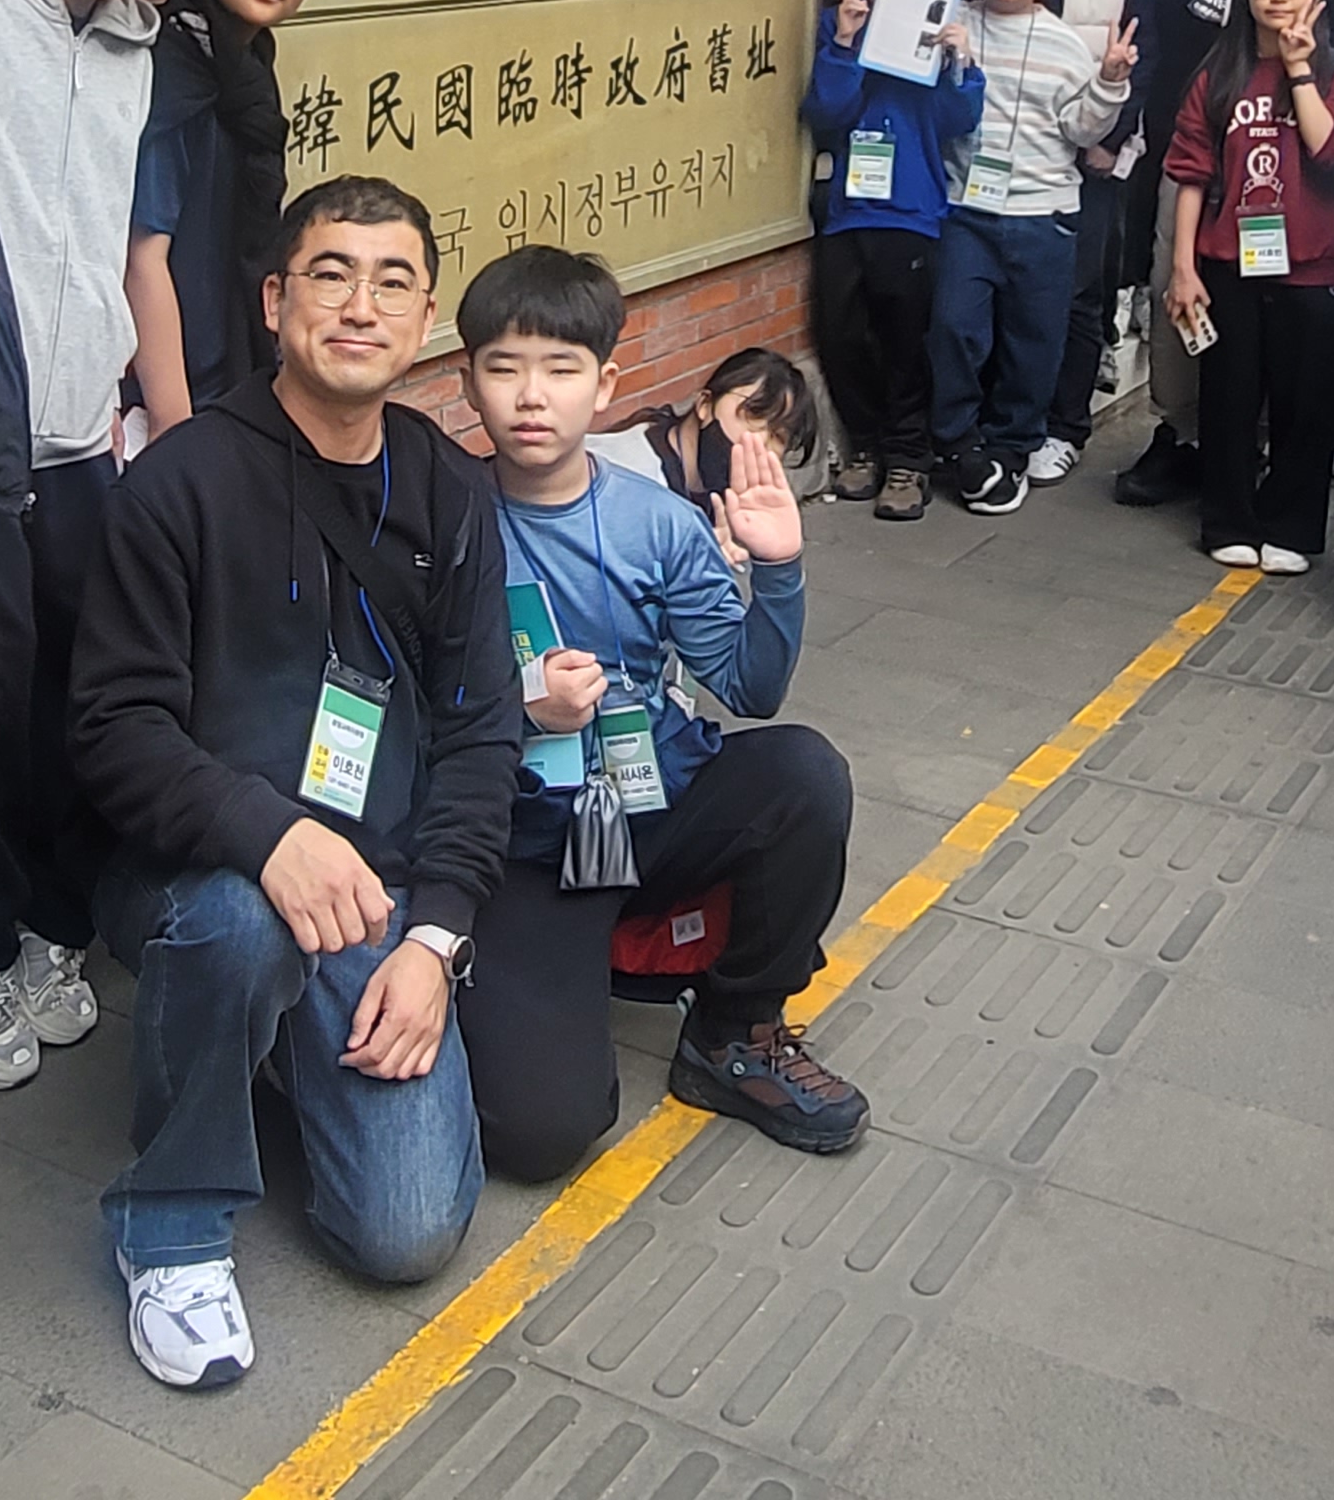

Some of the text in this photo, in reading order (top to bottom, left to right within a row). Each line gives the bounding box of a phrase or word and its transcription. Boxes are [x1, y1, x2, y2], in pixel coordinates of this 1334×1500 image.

[287, 17, 778, 173] 韓民國臨時政府舊址
[436, 142, 736, 276] 국 임시정부유적지
